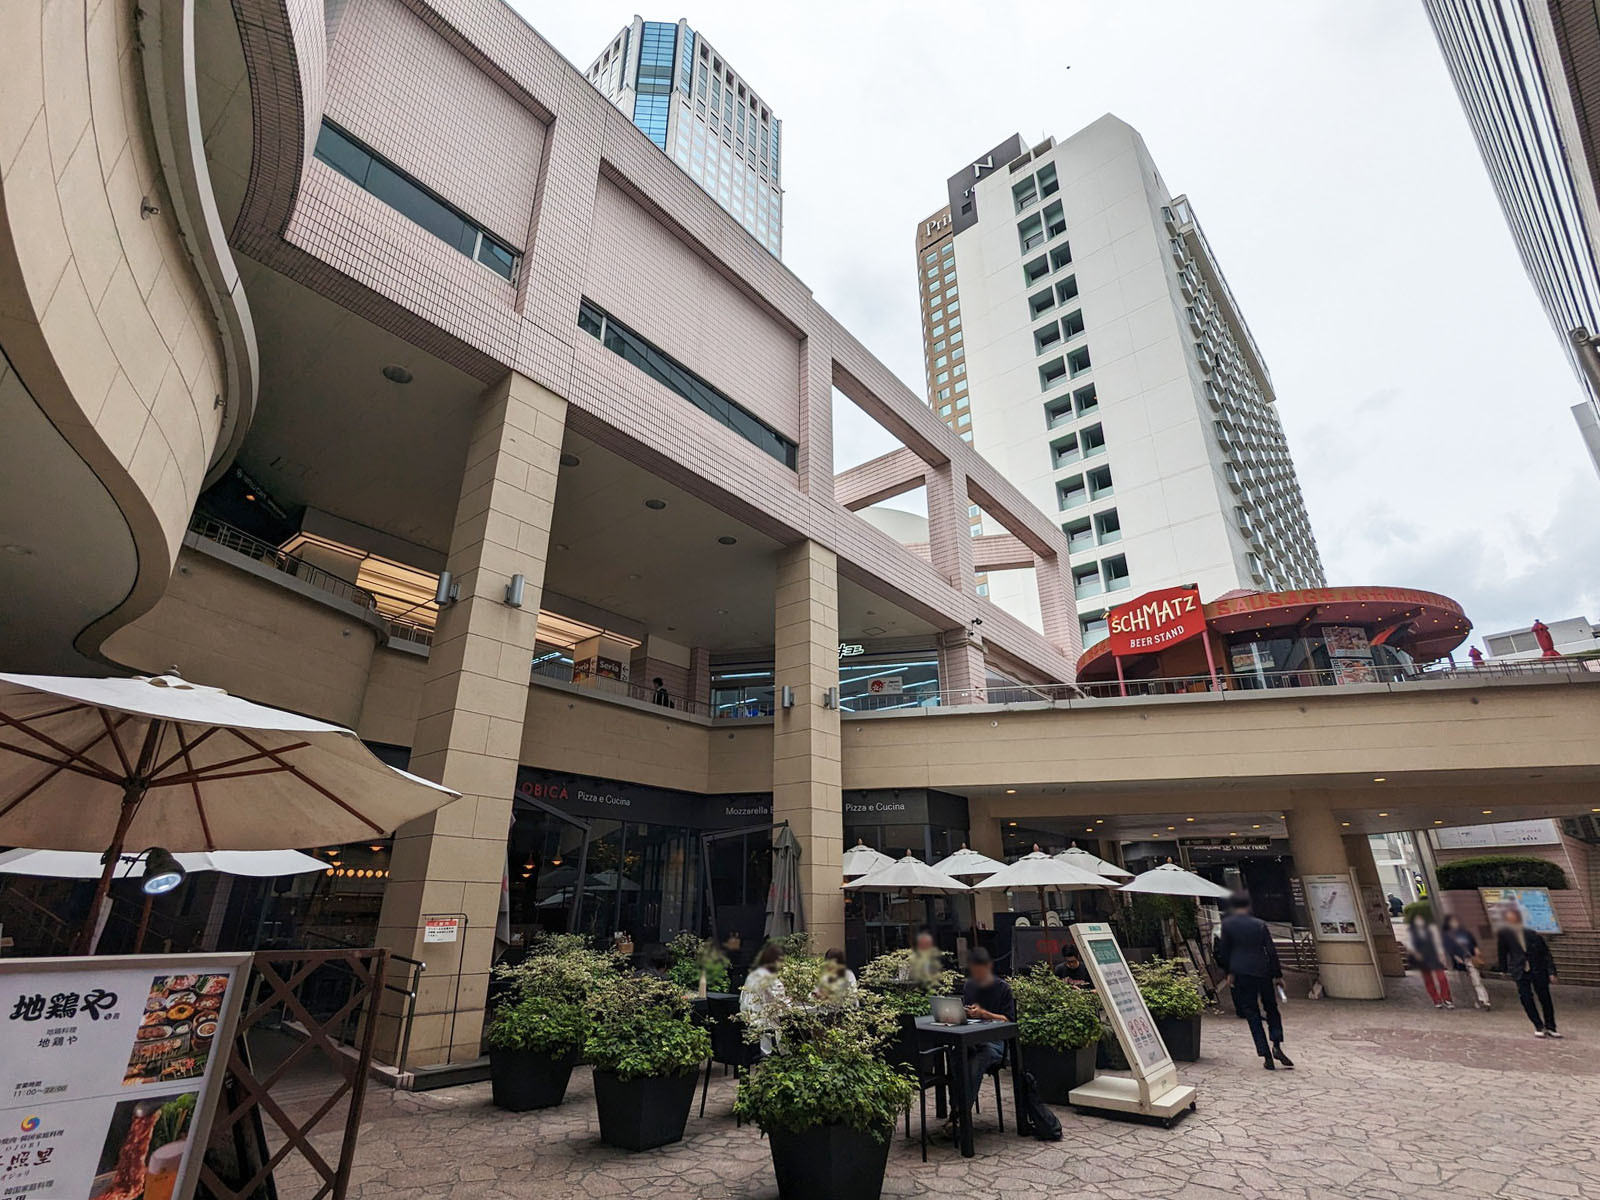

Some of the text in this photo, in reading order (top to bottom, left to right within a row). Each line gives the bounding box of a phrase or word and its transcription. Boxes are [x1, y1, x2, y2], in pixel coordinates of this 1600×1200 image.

[973, 155, 994, 178] N
[926, 213, 952, 236] Pri
[1111, 595, 1197, 634] SCHMATZ
[1130, 625, 1185, 648] BEER STAND
[599, 660, 619, 672] Seria
[577, 791, 598, 802] Pizza
[599, 795, 605, 803] e
[605, 795, 631, 806] Cucina
[845, 803, 867, 812] Pizza
[875, 802, 905, 812] Cucina
[725, 806, 768, 815] Mozzarella
